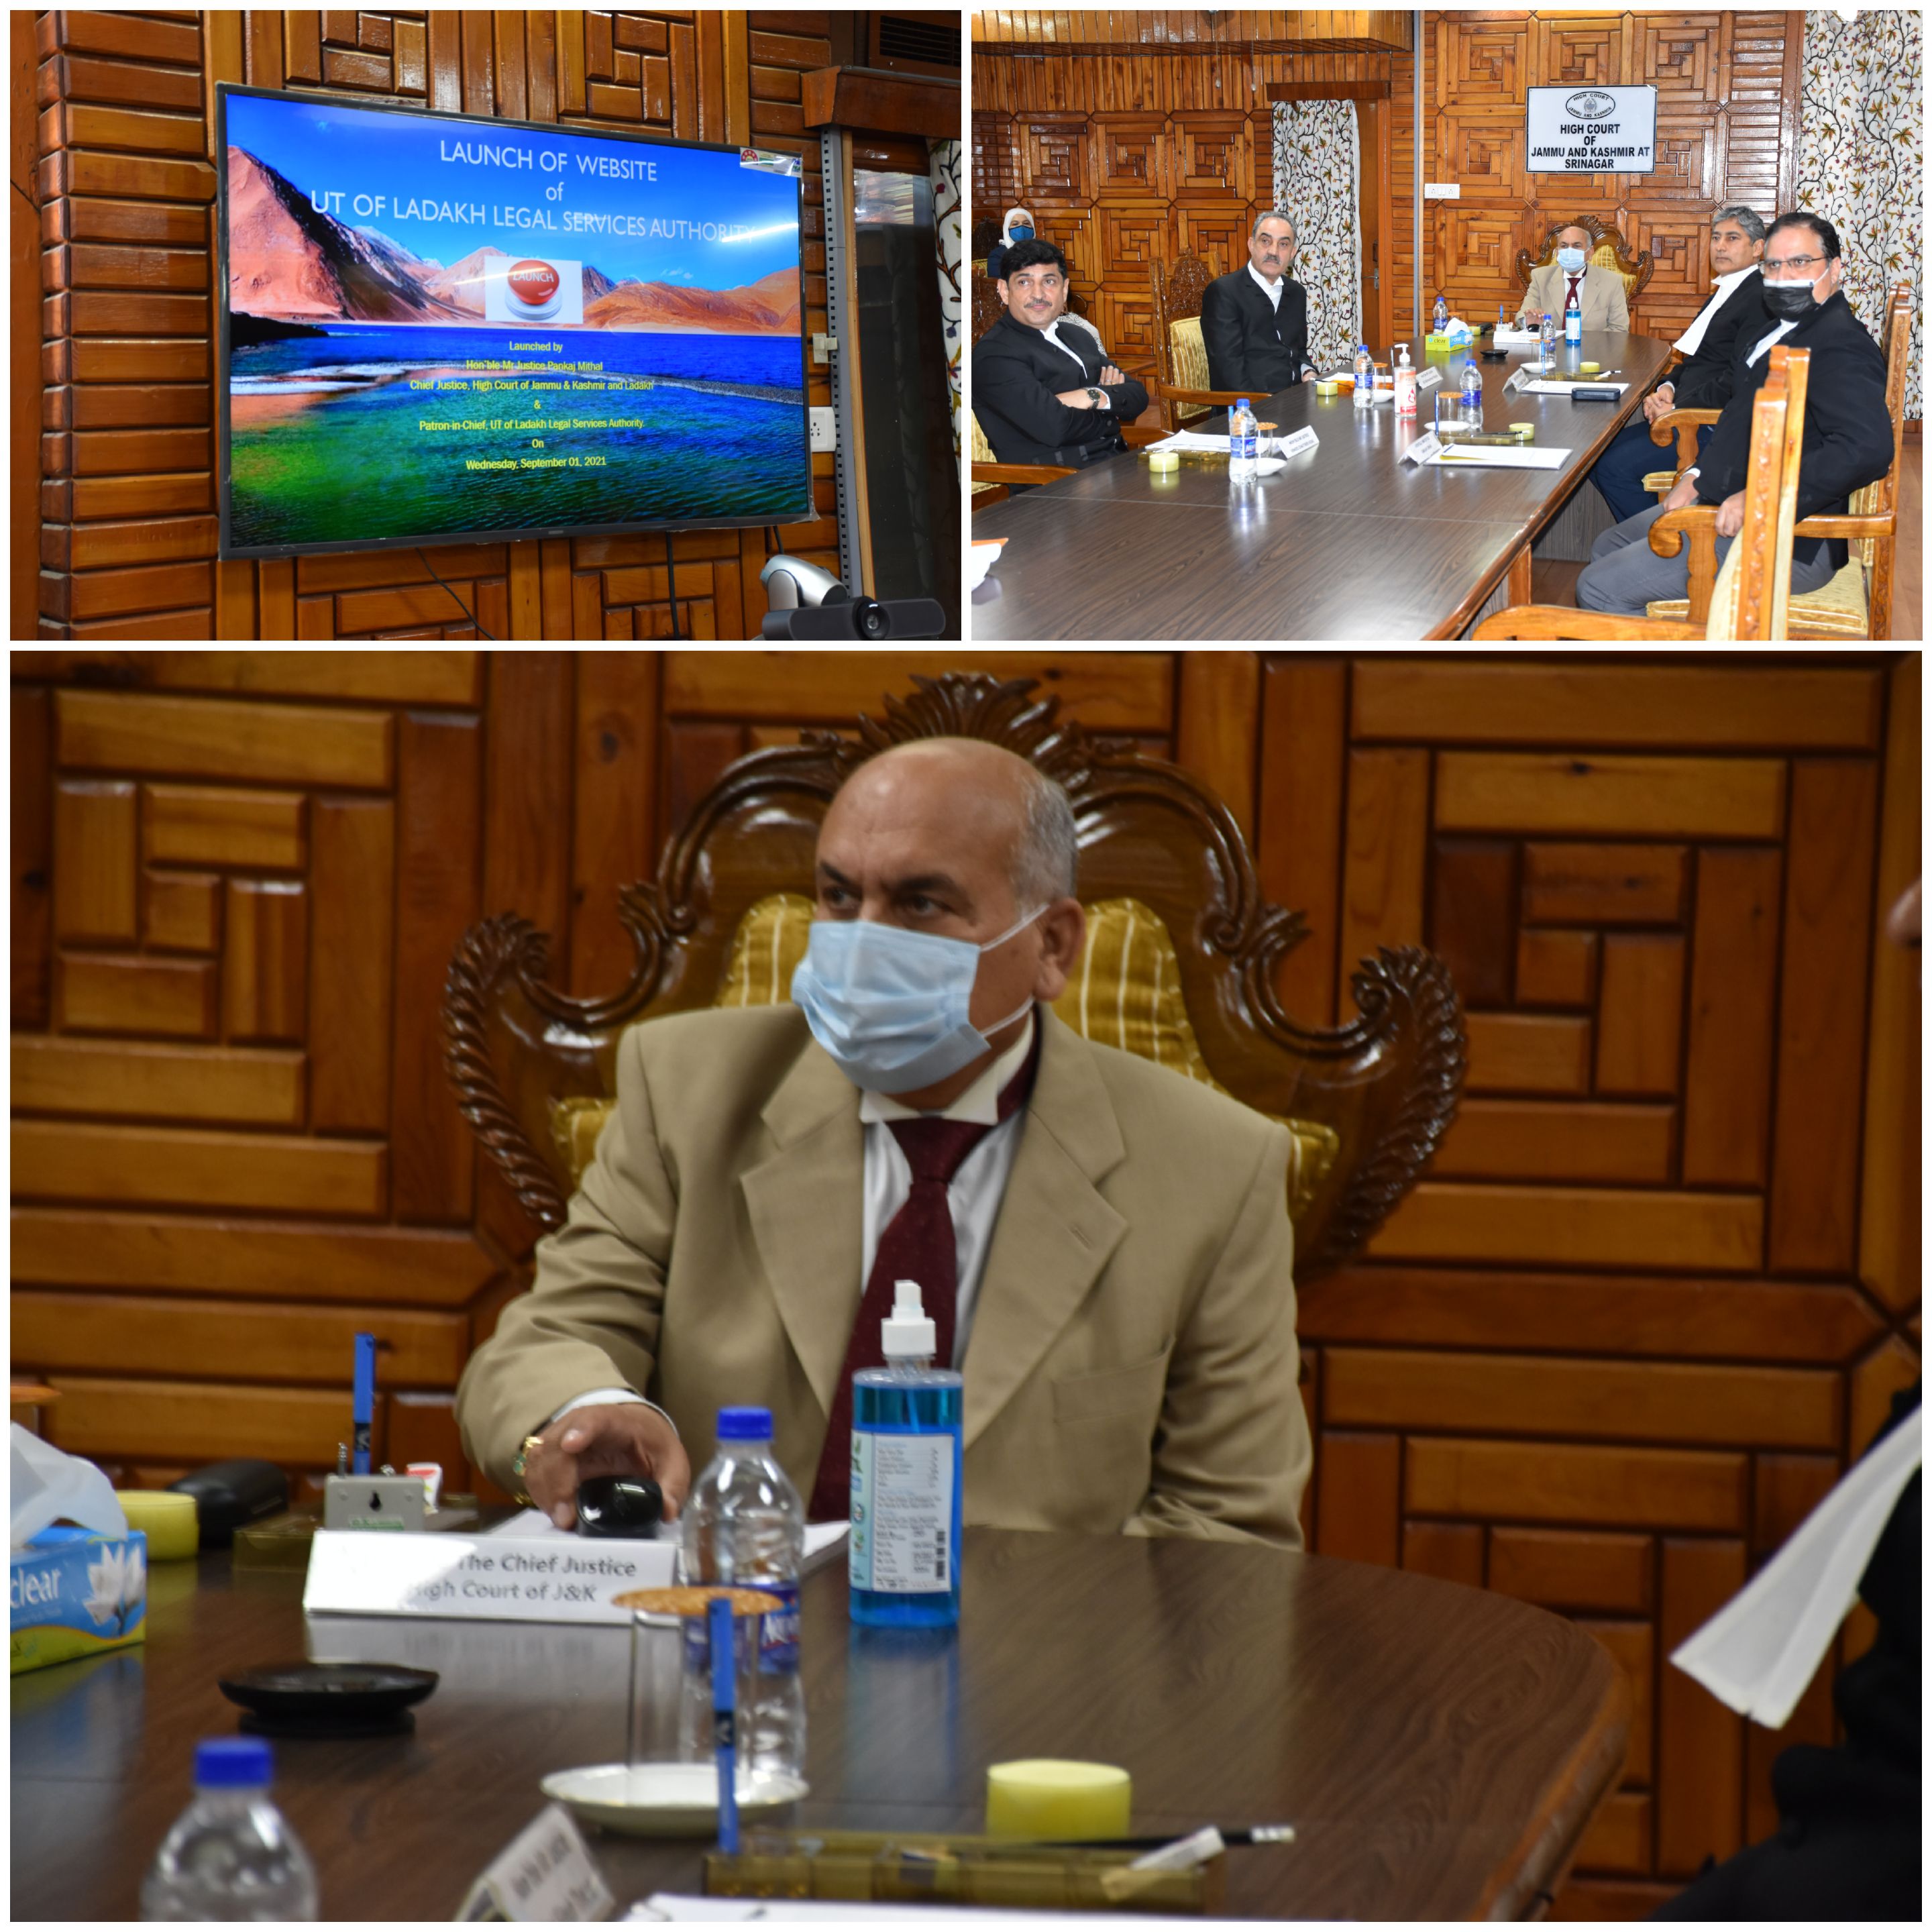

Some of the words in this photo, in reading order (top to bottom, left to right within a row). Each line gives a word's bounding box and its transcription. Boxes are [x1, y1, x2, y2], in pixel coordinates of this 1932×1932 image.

[1590, 93, 1609, 101] COURT
[1568, 107, 1582, 116] JAMMU
[1594, 106, 1612, 117] KASHMIR
[1560, 124, 1584, 134] HIGH
[1587, 123, 1620, 134] COURT
[1584, 136, 1596, 146] OF
[1531, 147, 1564, 157] JAMMU
[1568, 147, 1587, 157] AND
[1591, 147, 1635, 157] KASHMIR
[1638, 146, 1650, 157] AT
[440, 140, 533, 170] LAUNCH
[539, 151, 568, 172] OF
[576, 154, 657, 182] WEBSITE
[1565, 159, 1614, 168] SRINAGAR
[545, 182, 564, 201] of
[311, 190, 345, 215] UT
[353, 193, 386, 217] OF
[394, 197, 486, 225] LADAKH
[494, 205, 557, 231] LEGAL
[563, 211, 645, 237] SERVICES
[649, 218, 755, 244] AUTHORITY
[513, 272, 555, 282] LAUNCH
[509, 341, 551, 352] Launched
[553, 342, 563, 353] by
[502, 360, 515, 370] Mr
[517, 361, 545, 370] Justice
[547, 361, 576, 372] Pankaj
[578, 362, 603, 371] Mithal
[410, 380, 435, 390] Chief
[437, 380, 470, 390] Justice,
[473, 380, 492, 392] High
[494, 380, 519, 390] Court
[520, 380, 529, 390] of
[531, 380, 561, 390] Jammu
[564, 381, 570, 390] &
[572, 380, 606, 390] Kashmir
[608, 381, 623, 390] and
[625, 381, 654, 390] Ladakh
[534, 400, 541, 409] &
[419, 420, 488, 431] Patron-in-Chief,
[490, 420, 502, 429] UT
[504, 420, 513, 429] of
[515, 419, 546, 429] Ladakh
[549, 419, 570, 430] Legal
[573, 419, 607, 429] Services
[532, 439, 544, 448] On
[466, 460, 519, 470] Wednesday,
[521, 458, 567, 469] September
[569, 458, 582, 467] 01,
[584, 456, 606, 466] 2021
[501, 1553, 558, 1573] Chief
[562, 1556, 637, 1576] Justice
[462, 1580, 519, 1599] Court
[525, 1580, 550, 1601] of
[551, 1582, 597, 1602] J&K
